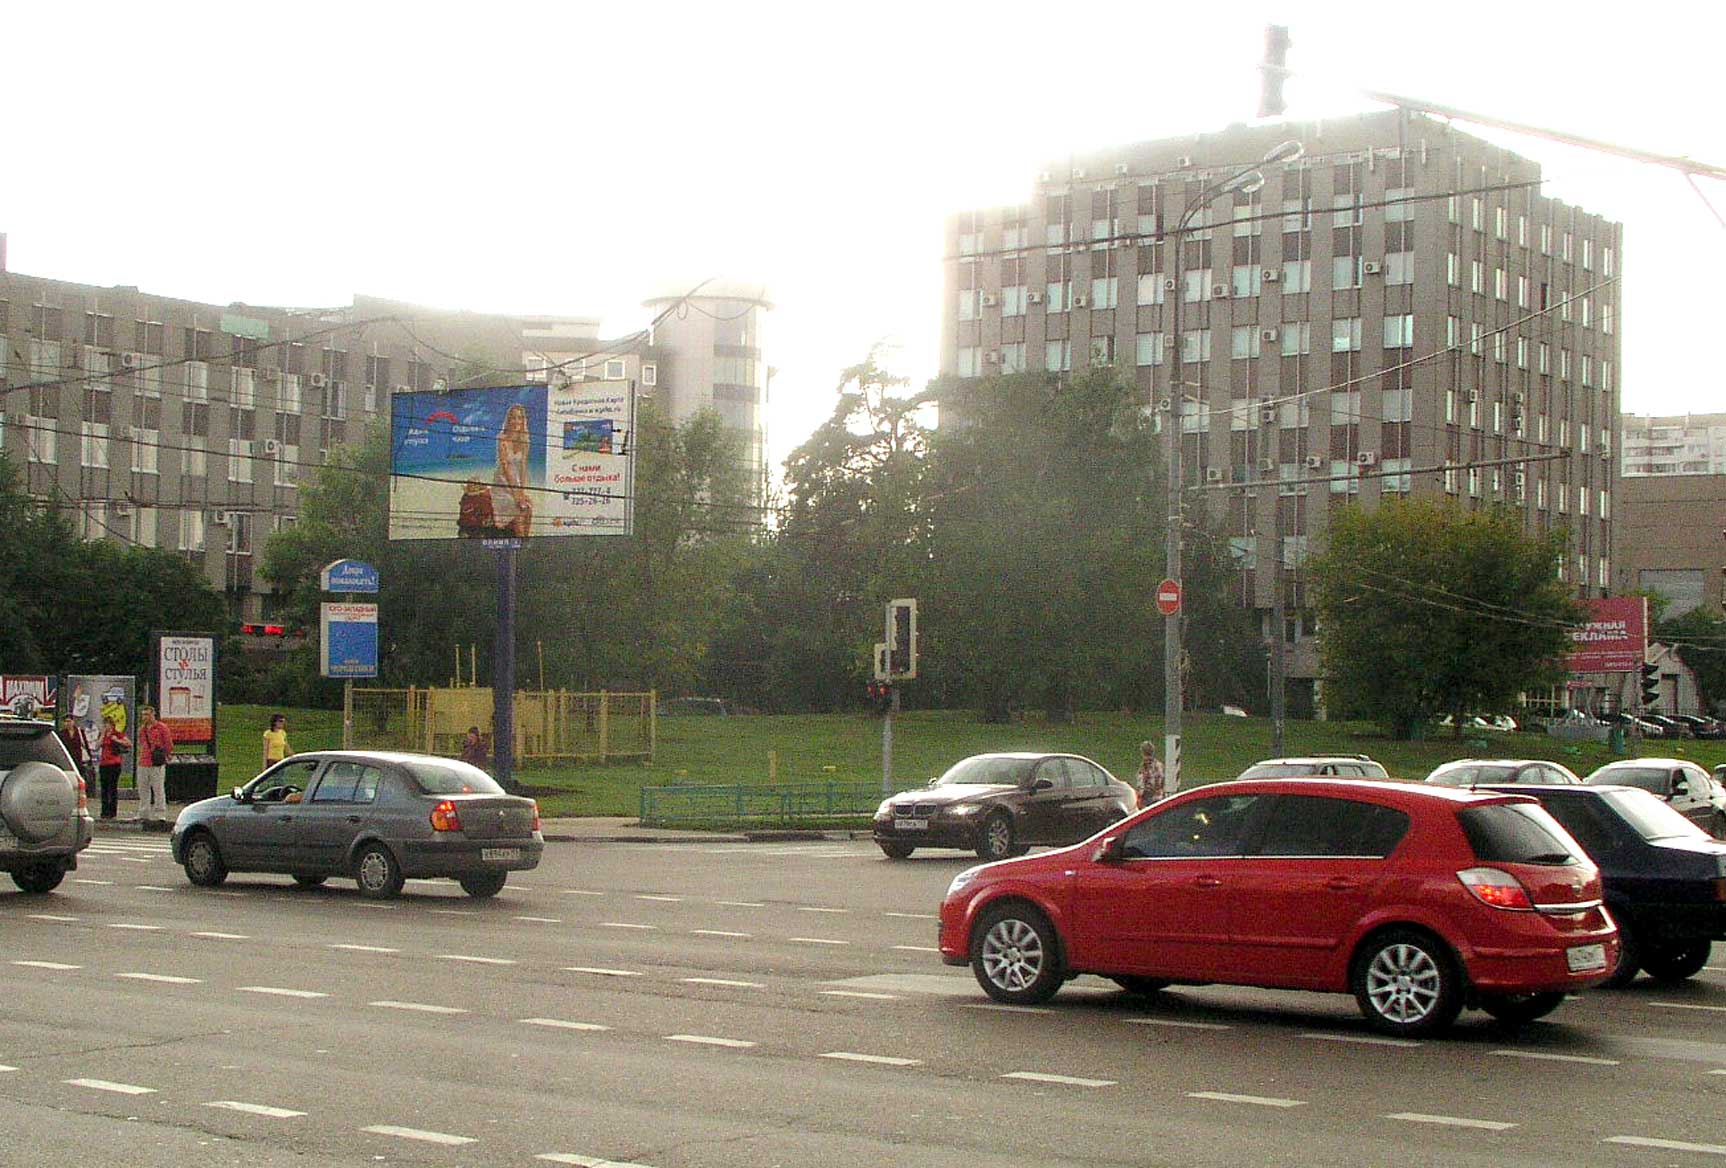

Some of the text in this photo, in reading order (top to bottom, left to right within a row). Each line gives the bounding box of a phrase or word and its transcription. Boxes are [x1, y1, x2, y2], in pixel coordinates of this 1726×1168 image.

[553, 473, 586, 483] больше
[164, 646, 208, 661] СТОЛЫ
[164, 667, 208, 681] СТУЛЬЯ
